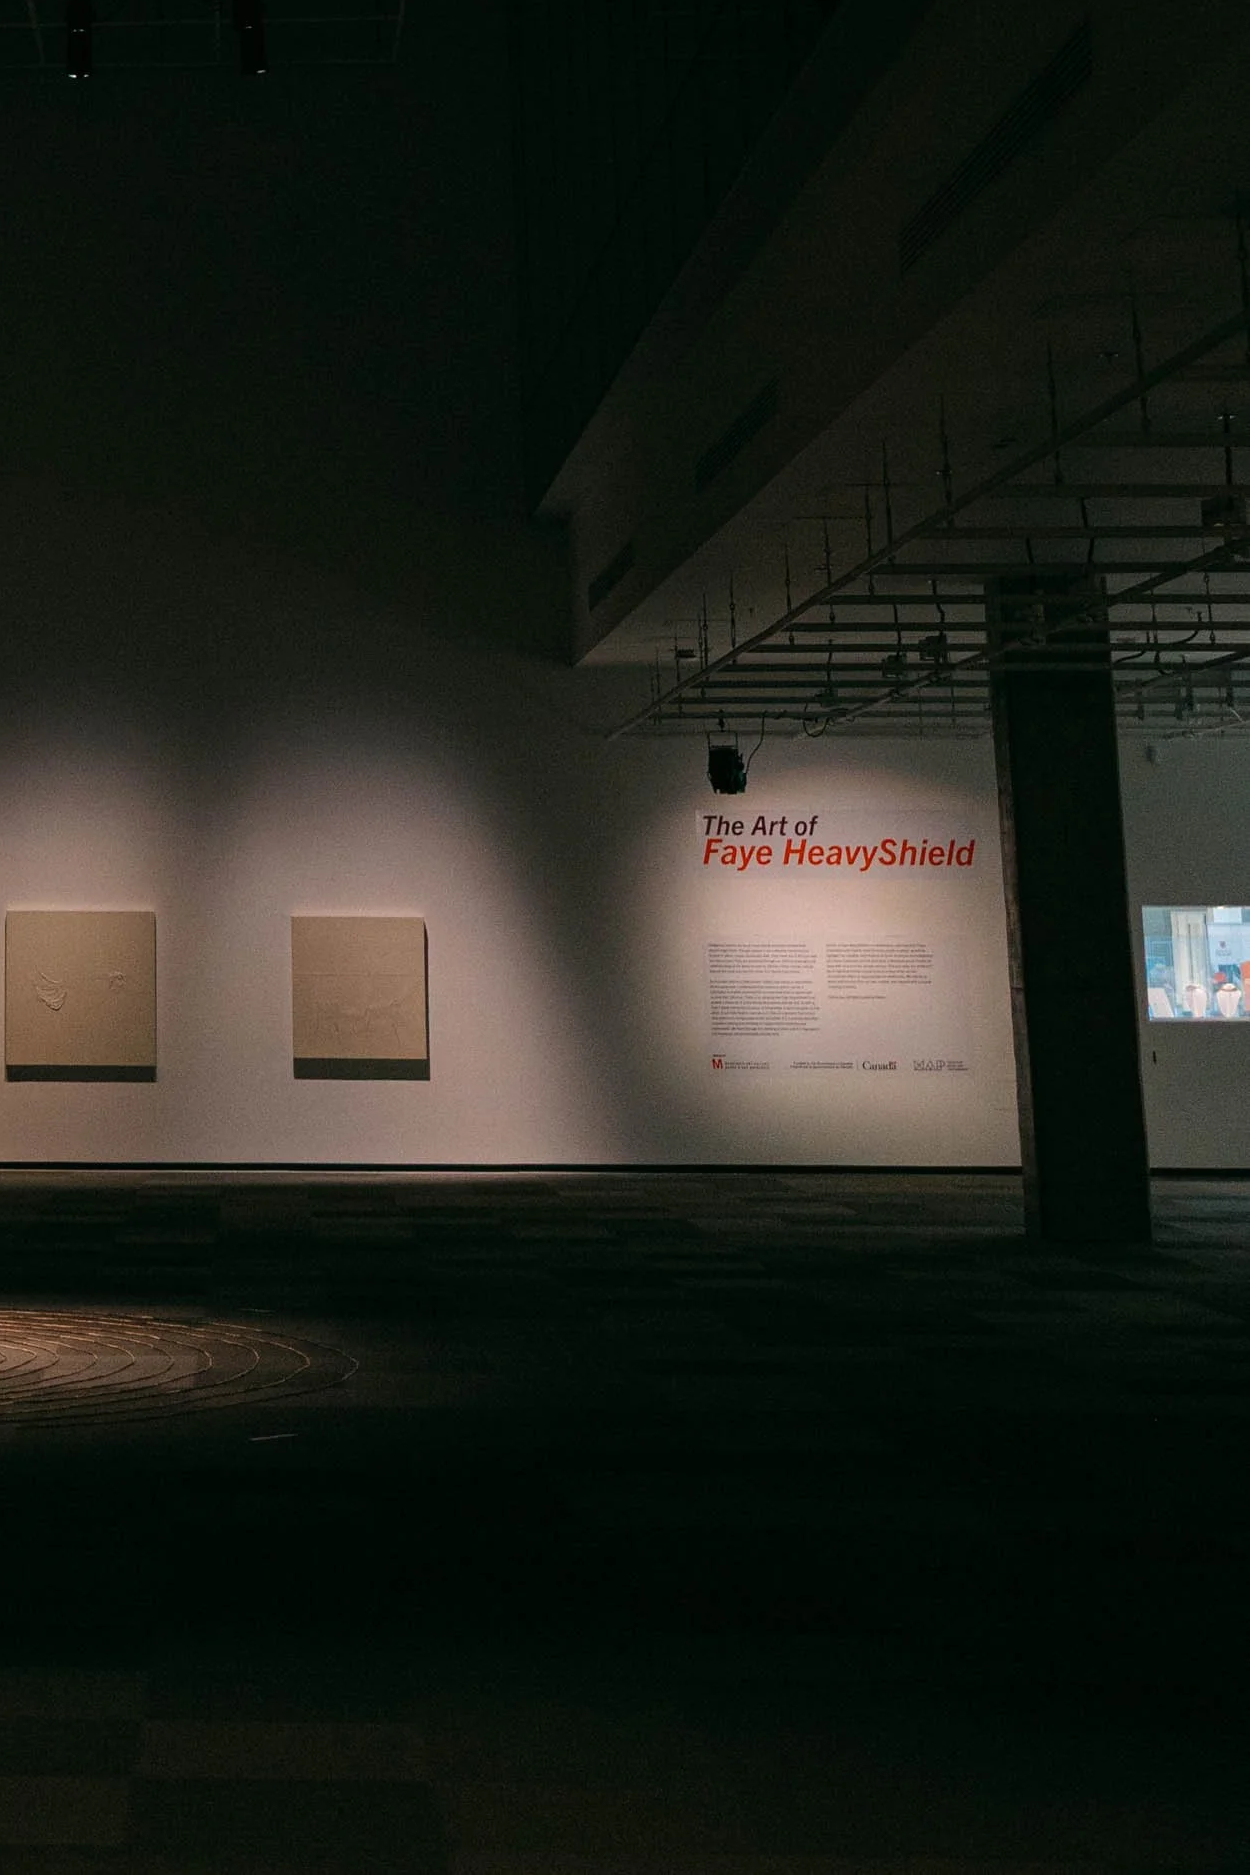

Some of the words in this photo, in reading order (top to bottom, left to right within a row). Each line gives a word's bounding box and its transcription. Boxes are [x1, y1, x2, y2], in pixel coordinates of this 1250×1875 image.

[703, 815, 744, 836] The
[751, 815, 788, 836] Art
[794, 815, 819, 836] of
[703, 838, 773, 871] Faye
[783, 838, 976, 871] HeavyShield
[712, 1058, 724, 1070] M
[862, 1060, 897, 1071] Canada
